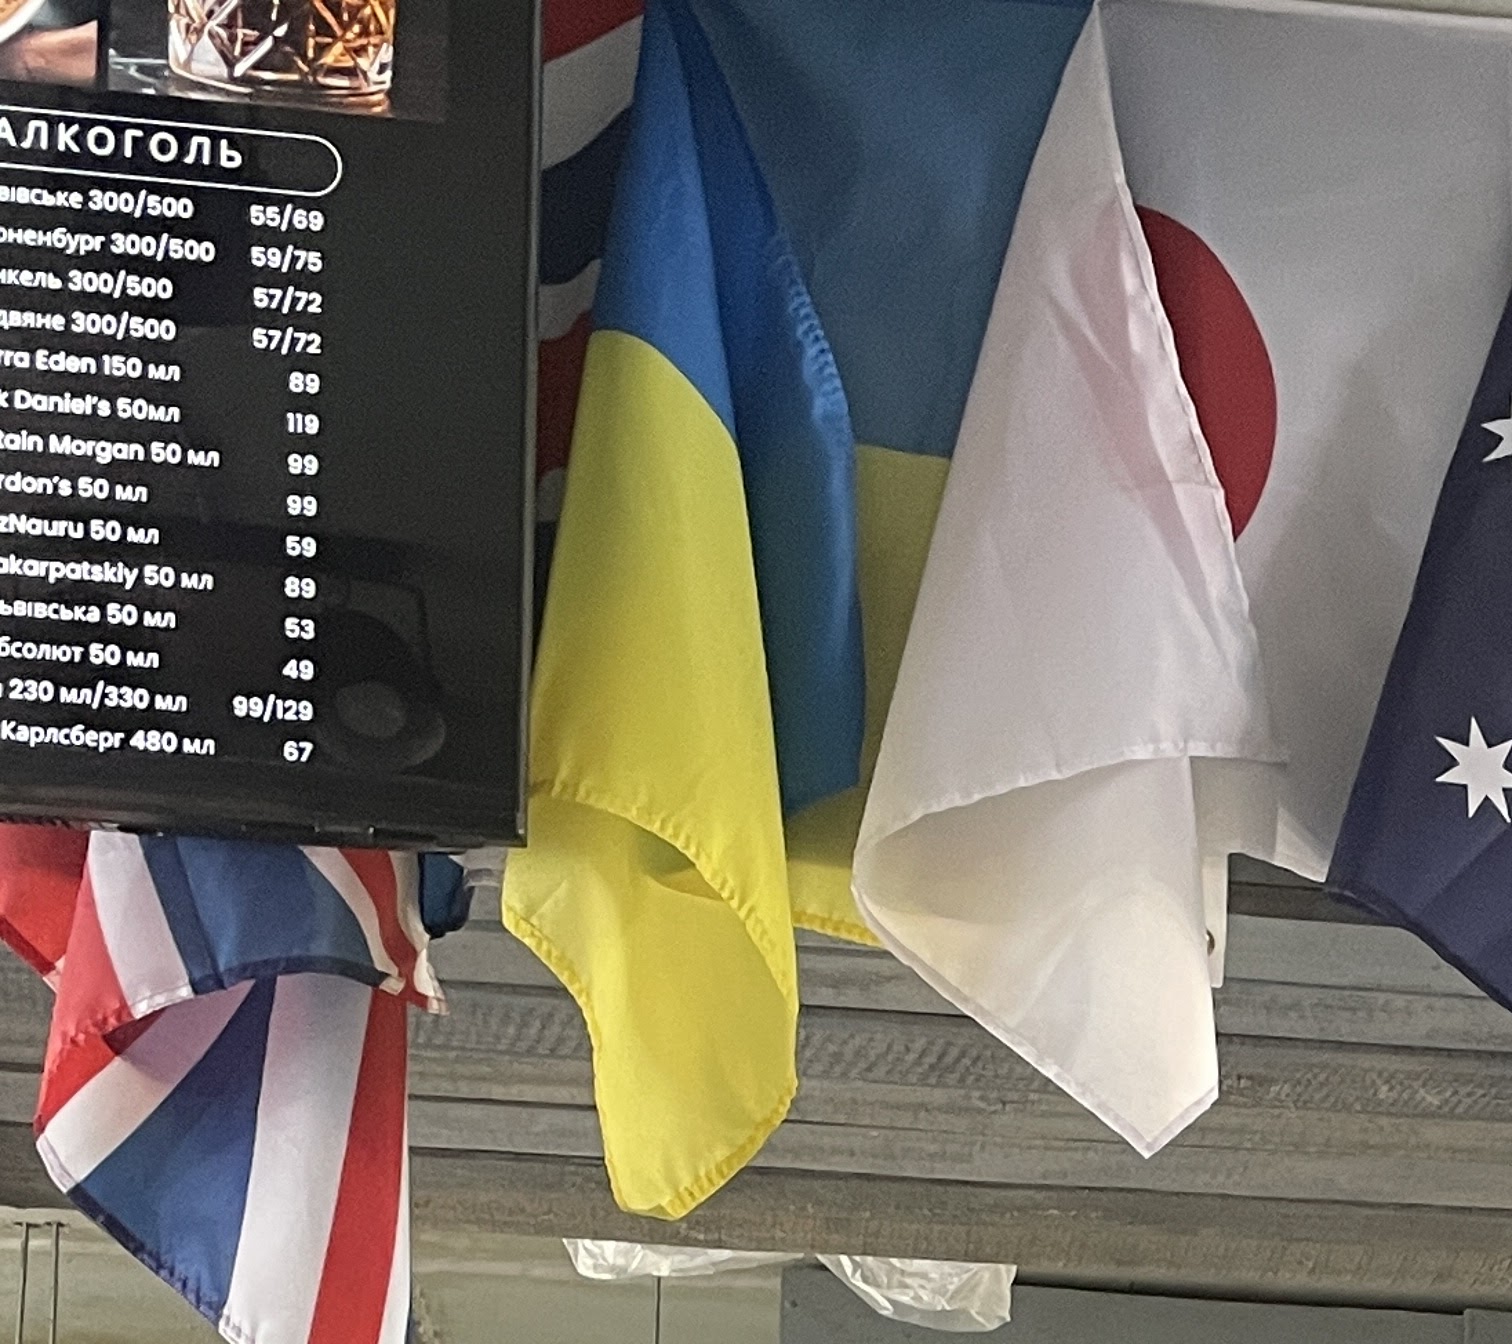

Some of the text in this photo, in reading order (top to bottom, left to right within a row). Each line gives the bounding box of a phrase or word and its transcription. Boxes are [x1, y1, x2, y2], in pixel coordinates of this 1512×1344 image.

[0, 117, 242, 168] АЛКОГОЛЬ
[88, 189, 194, 218] 300/500
[250, 204, 324, 231] 55/69
[110, 233, 322, 272] 300/500 59/75
[68, 269, 322, 314] 300/500 57/72
[71, 311, 321, 355] 300/500 57/72
[35, 349, 320, 394] Eden 150 мл 89
[116, 397, 180, 422] 50мл
[287, 413, 319, 434] 119
[49, 434, 318, 475] Morgan 50 мл 99
[78, 476, 317, 516] 50 мл 99
[90, 519, 122, 541] 50
[127, 527, 159, 544] мл
[286, 535, 316, 557] 59
[144, 565, 175, 587] 50
[181, 573, 213, 590] мл
[284, 576, 316, 598] 89
[107, 603, 138, 625] 50
[143, 611, 175, 628] мл
[285, 617, 315, 640] 53
[89, 643, 121, 665] 50
[126, 651, 159, 668] мл
[282, 659, 314, 680] 49
[9, 678, 313, 722] 230 мл/330 мл 99/129
[0, 720, 313, 762] Карлсберг 480 мл 67
